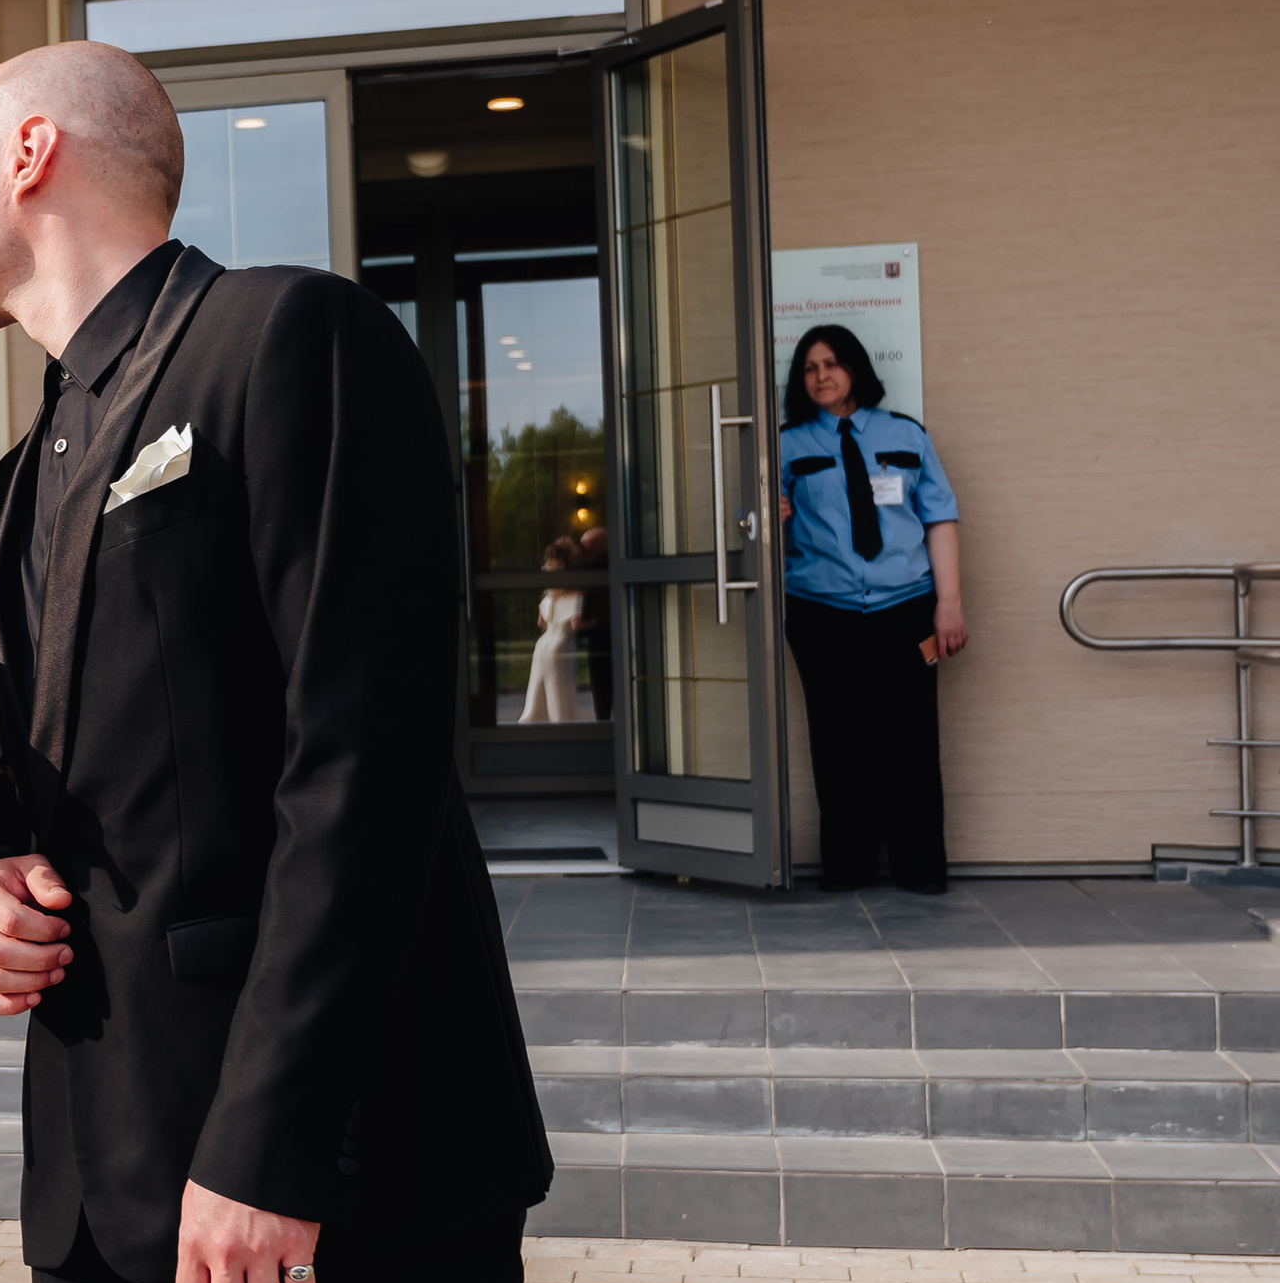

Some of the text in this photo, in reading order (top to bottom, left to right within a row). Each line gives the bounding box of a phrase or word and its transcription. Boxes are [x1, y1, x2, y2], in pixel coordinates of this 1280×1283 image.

[774, 297, 902, 314] орец бракосочетания
[874, 351, 903, 361] 18:00
